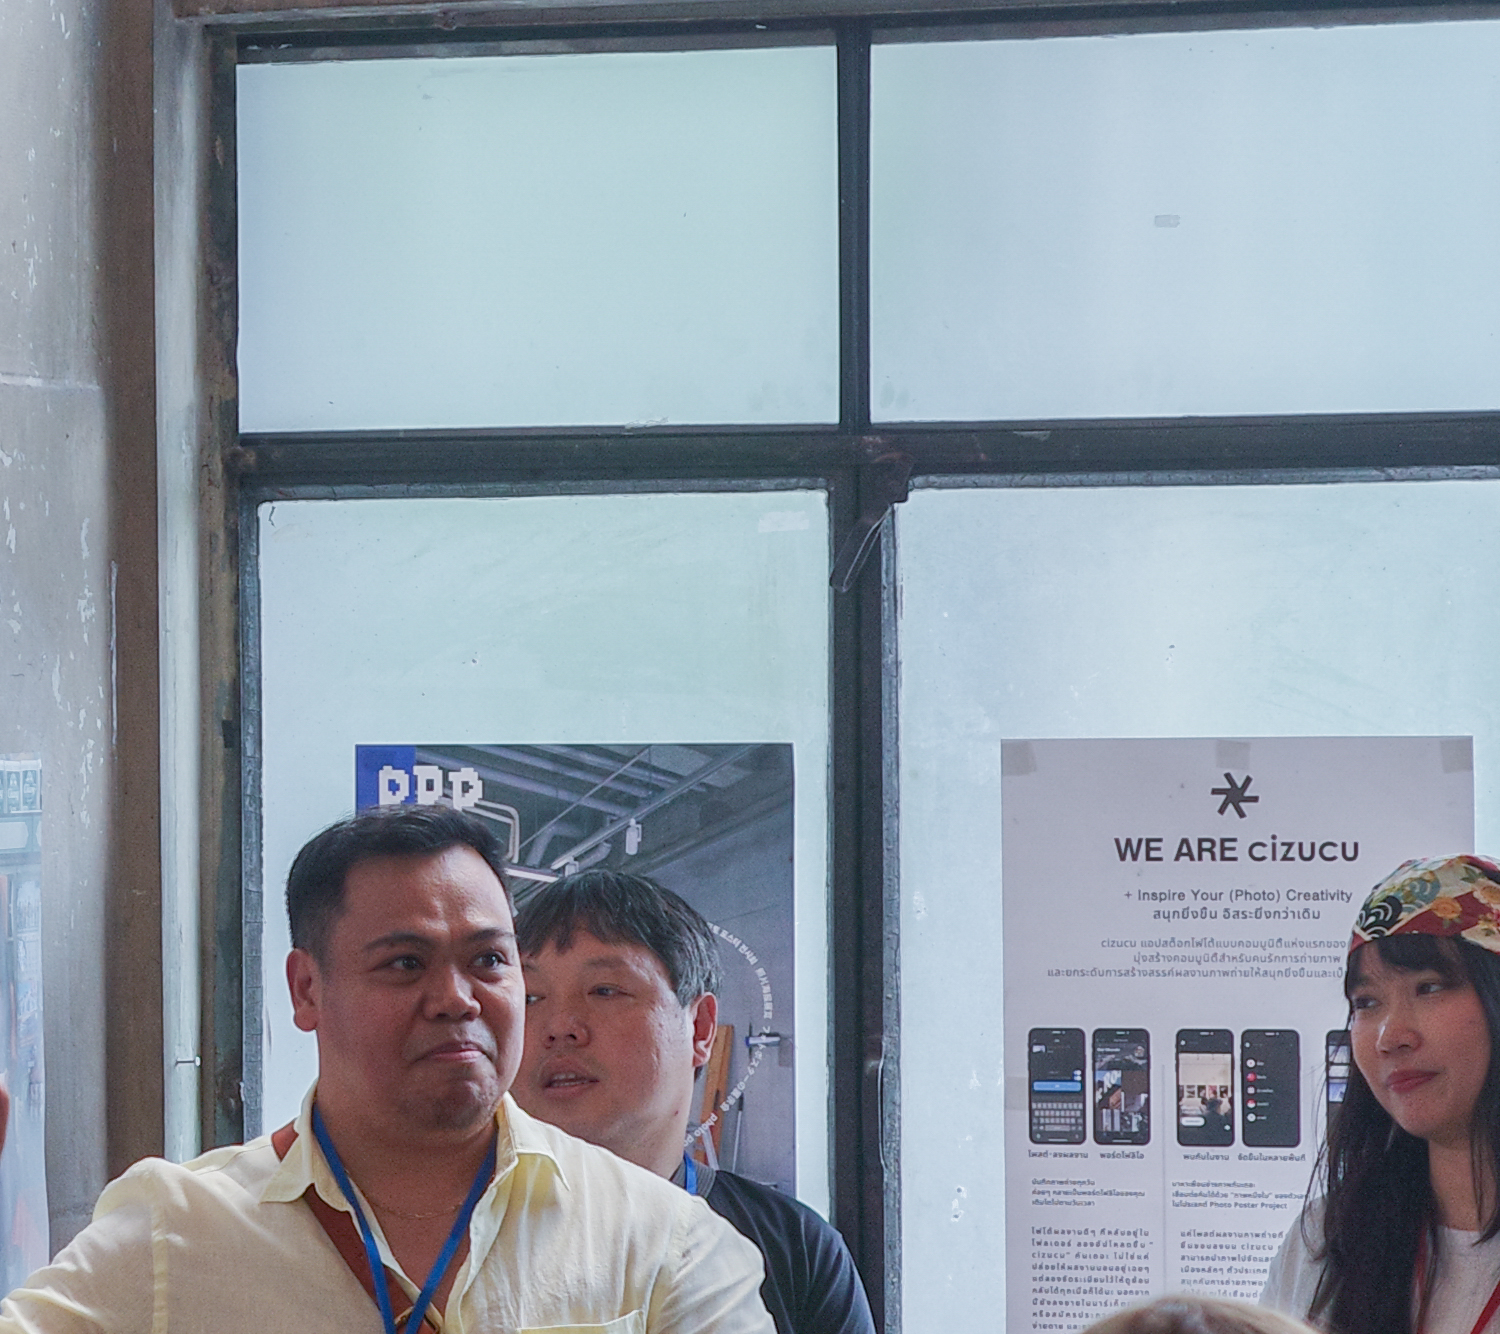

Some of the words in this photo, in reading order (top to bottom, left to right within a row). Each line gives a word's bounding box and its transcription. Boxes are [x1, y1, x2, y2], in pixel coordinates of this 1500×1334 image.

[1114, 837, 1163, 862] WE
[1174, 837, 1239, 862] ARE
[1248, 834, 1359, 862] cizucu
[1137, 888, 1186, 904] Inspire
[1190, 889, 1224, 902] Your
[1229, 888, 1281, 904] (Photo)
[1286, 888, 1353, 905] Creativity
[1100, 937, 1137, 948] cizucu
[1209, 1201, 1232, 1209] Photo
[1233, 1201, 1258, 1209] Poster
[1260, 1201, 1288, 1211] Project
